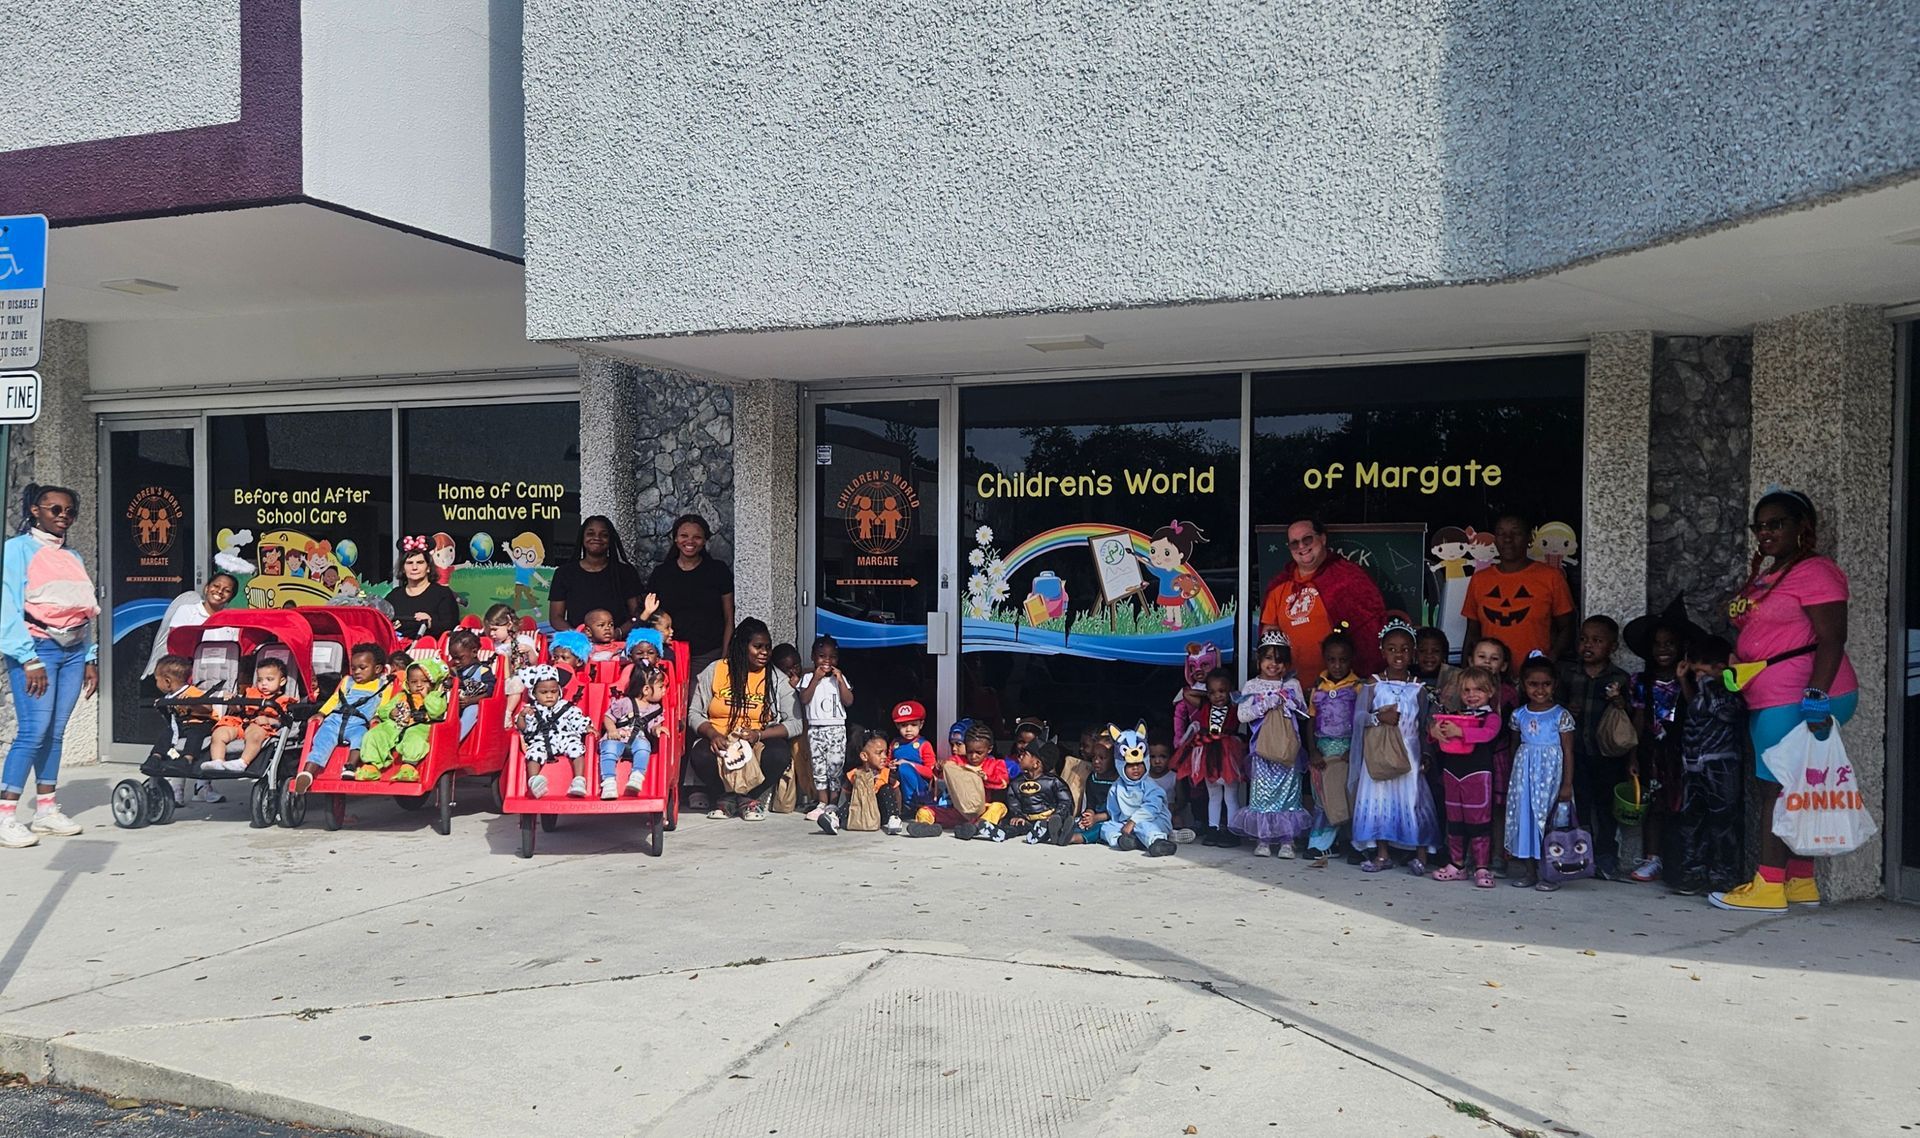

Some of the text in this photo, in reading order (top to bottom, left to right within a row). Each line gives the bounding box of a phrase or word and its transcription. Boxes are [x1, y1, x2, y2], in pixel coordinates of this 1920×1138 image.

[8, 299, 38, 309] DISABLED
[8, 315, 23, 325] ONLY
[11, 330, 28, 340] ZONE
[7, 386, 34, 409] FINE
[977, 459, 1502, 498] Children's World of Margate
[234, 487, 371, 504] Before and After
[438, 481, 565, 502] Home of Camp
[837, 470, 920, 509] CHILDREN'S WORLD
[126, 486, 183, 519] CHILDREN'S WORLD
[442, 502, 561, 520] Wanahave Fun
[256, 508, 347, 524] School Care
[140, 557, 169, 566] MARGATE
[857, 556, 899, 567] MARGATE
